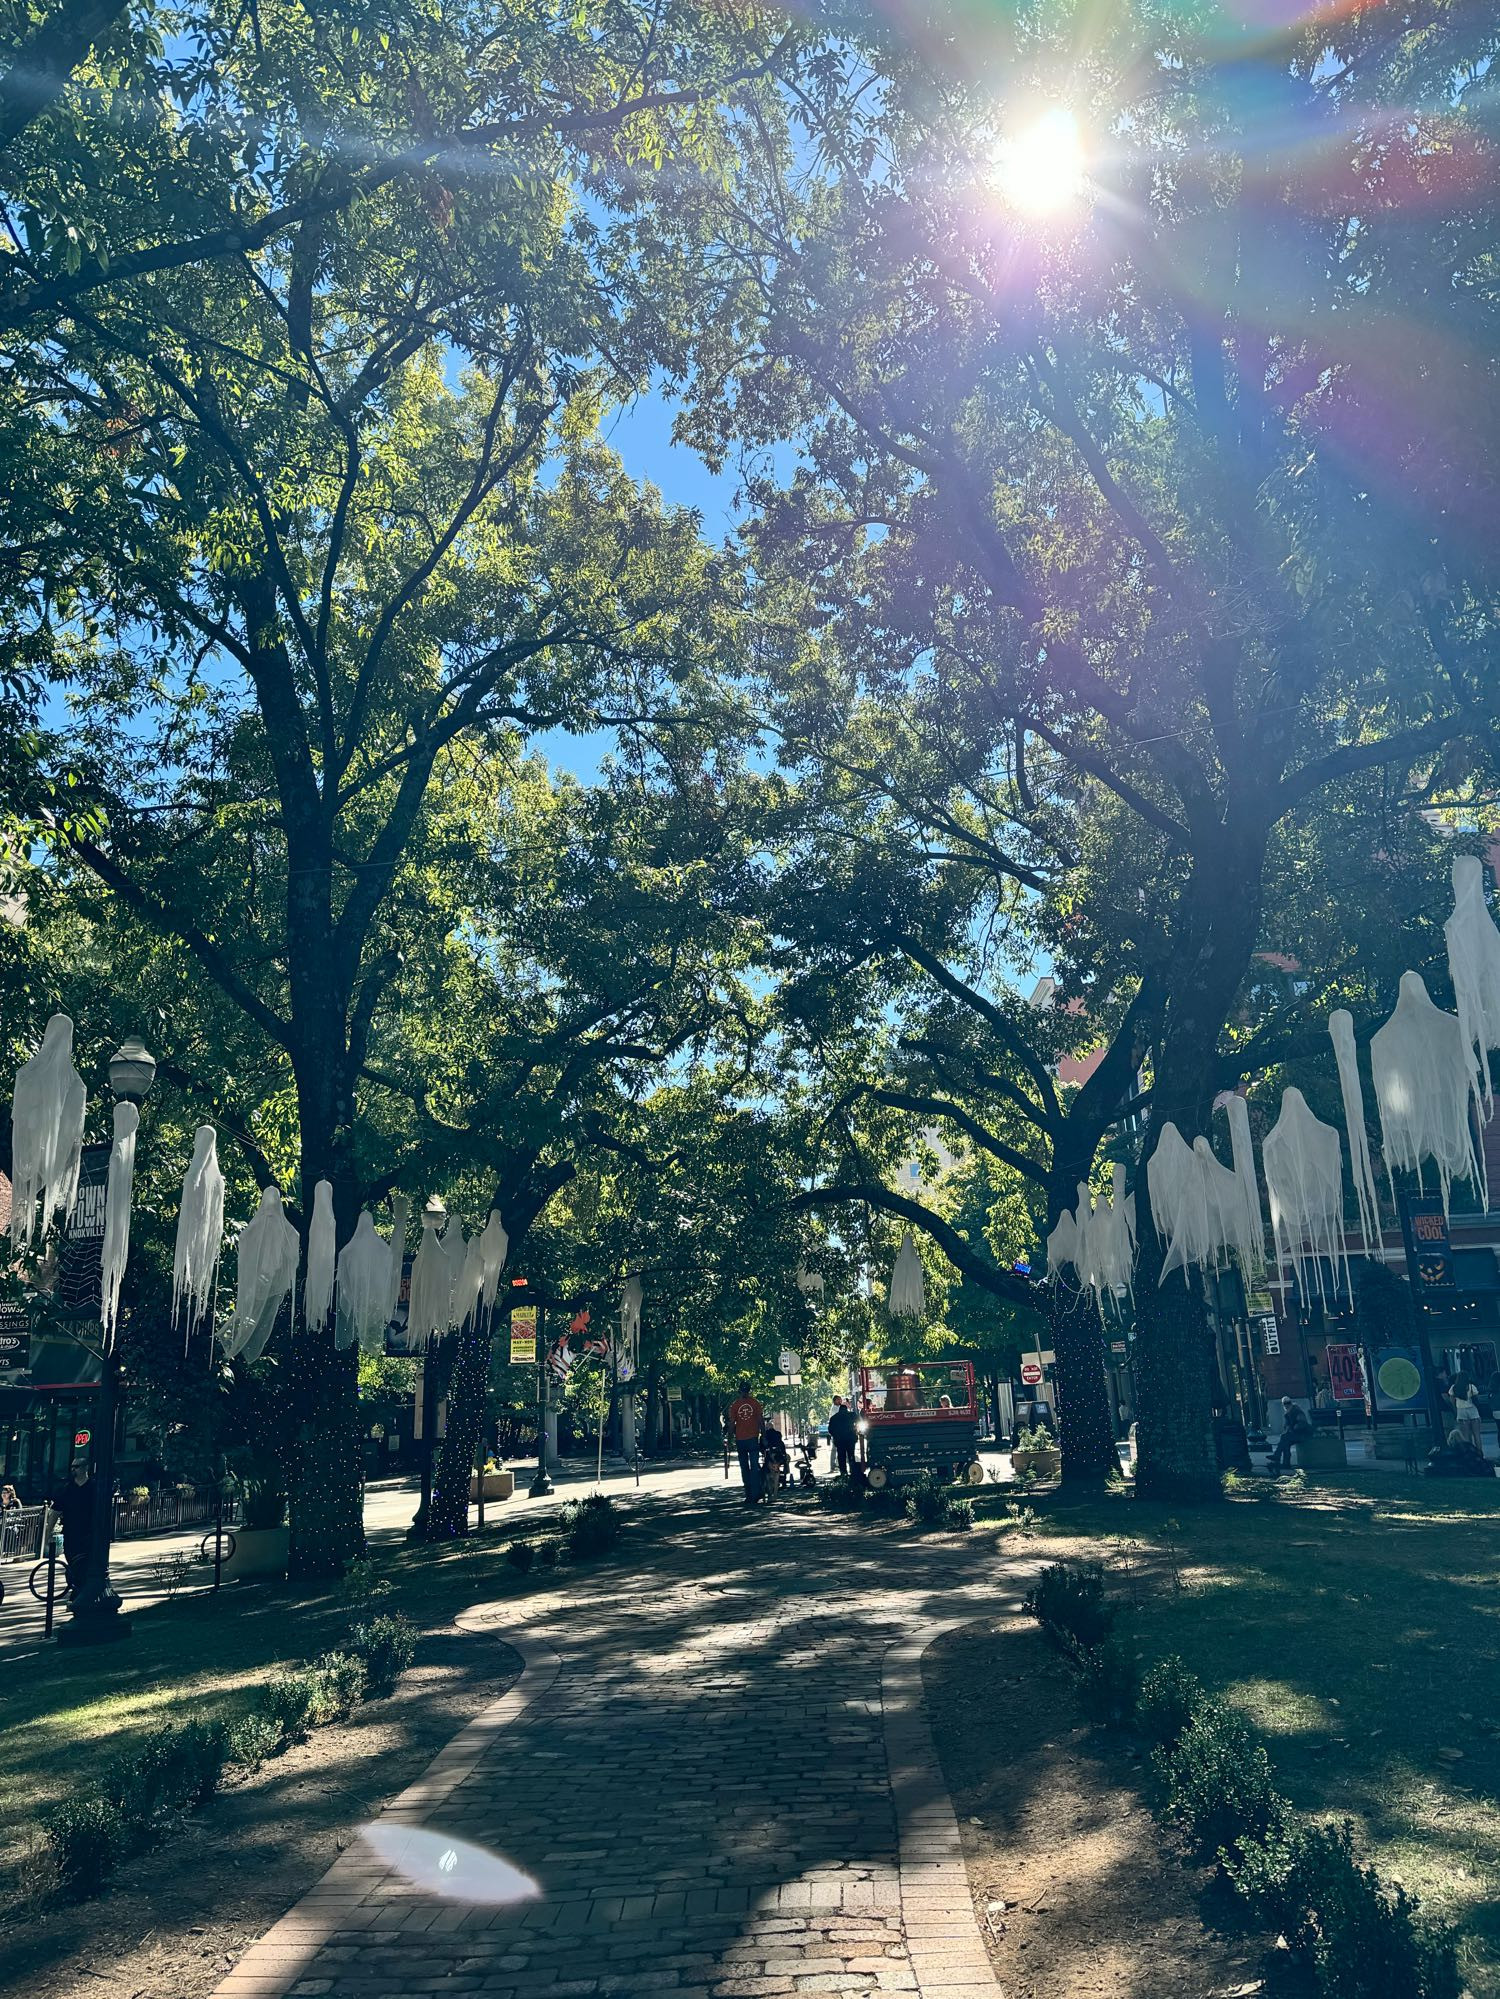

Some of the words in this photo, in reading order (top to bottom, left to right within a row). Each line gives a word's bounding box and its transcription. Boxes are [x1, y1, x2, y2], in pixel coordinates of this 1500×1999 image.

[79, 1184, 106, 1217] OWN
[1415, 1215, 1444, 1226] WICKED
[68, 1226, 105, 1239] KNOXVILLE
[1417, 1225, 1446, 1240] COOL
[1267, 1320, 1279, 1353] OUTFIT
